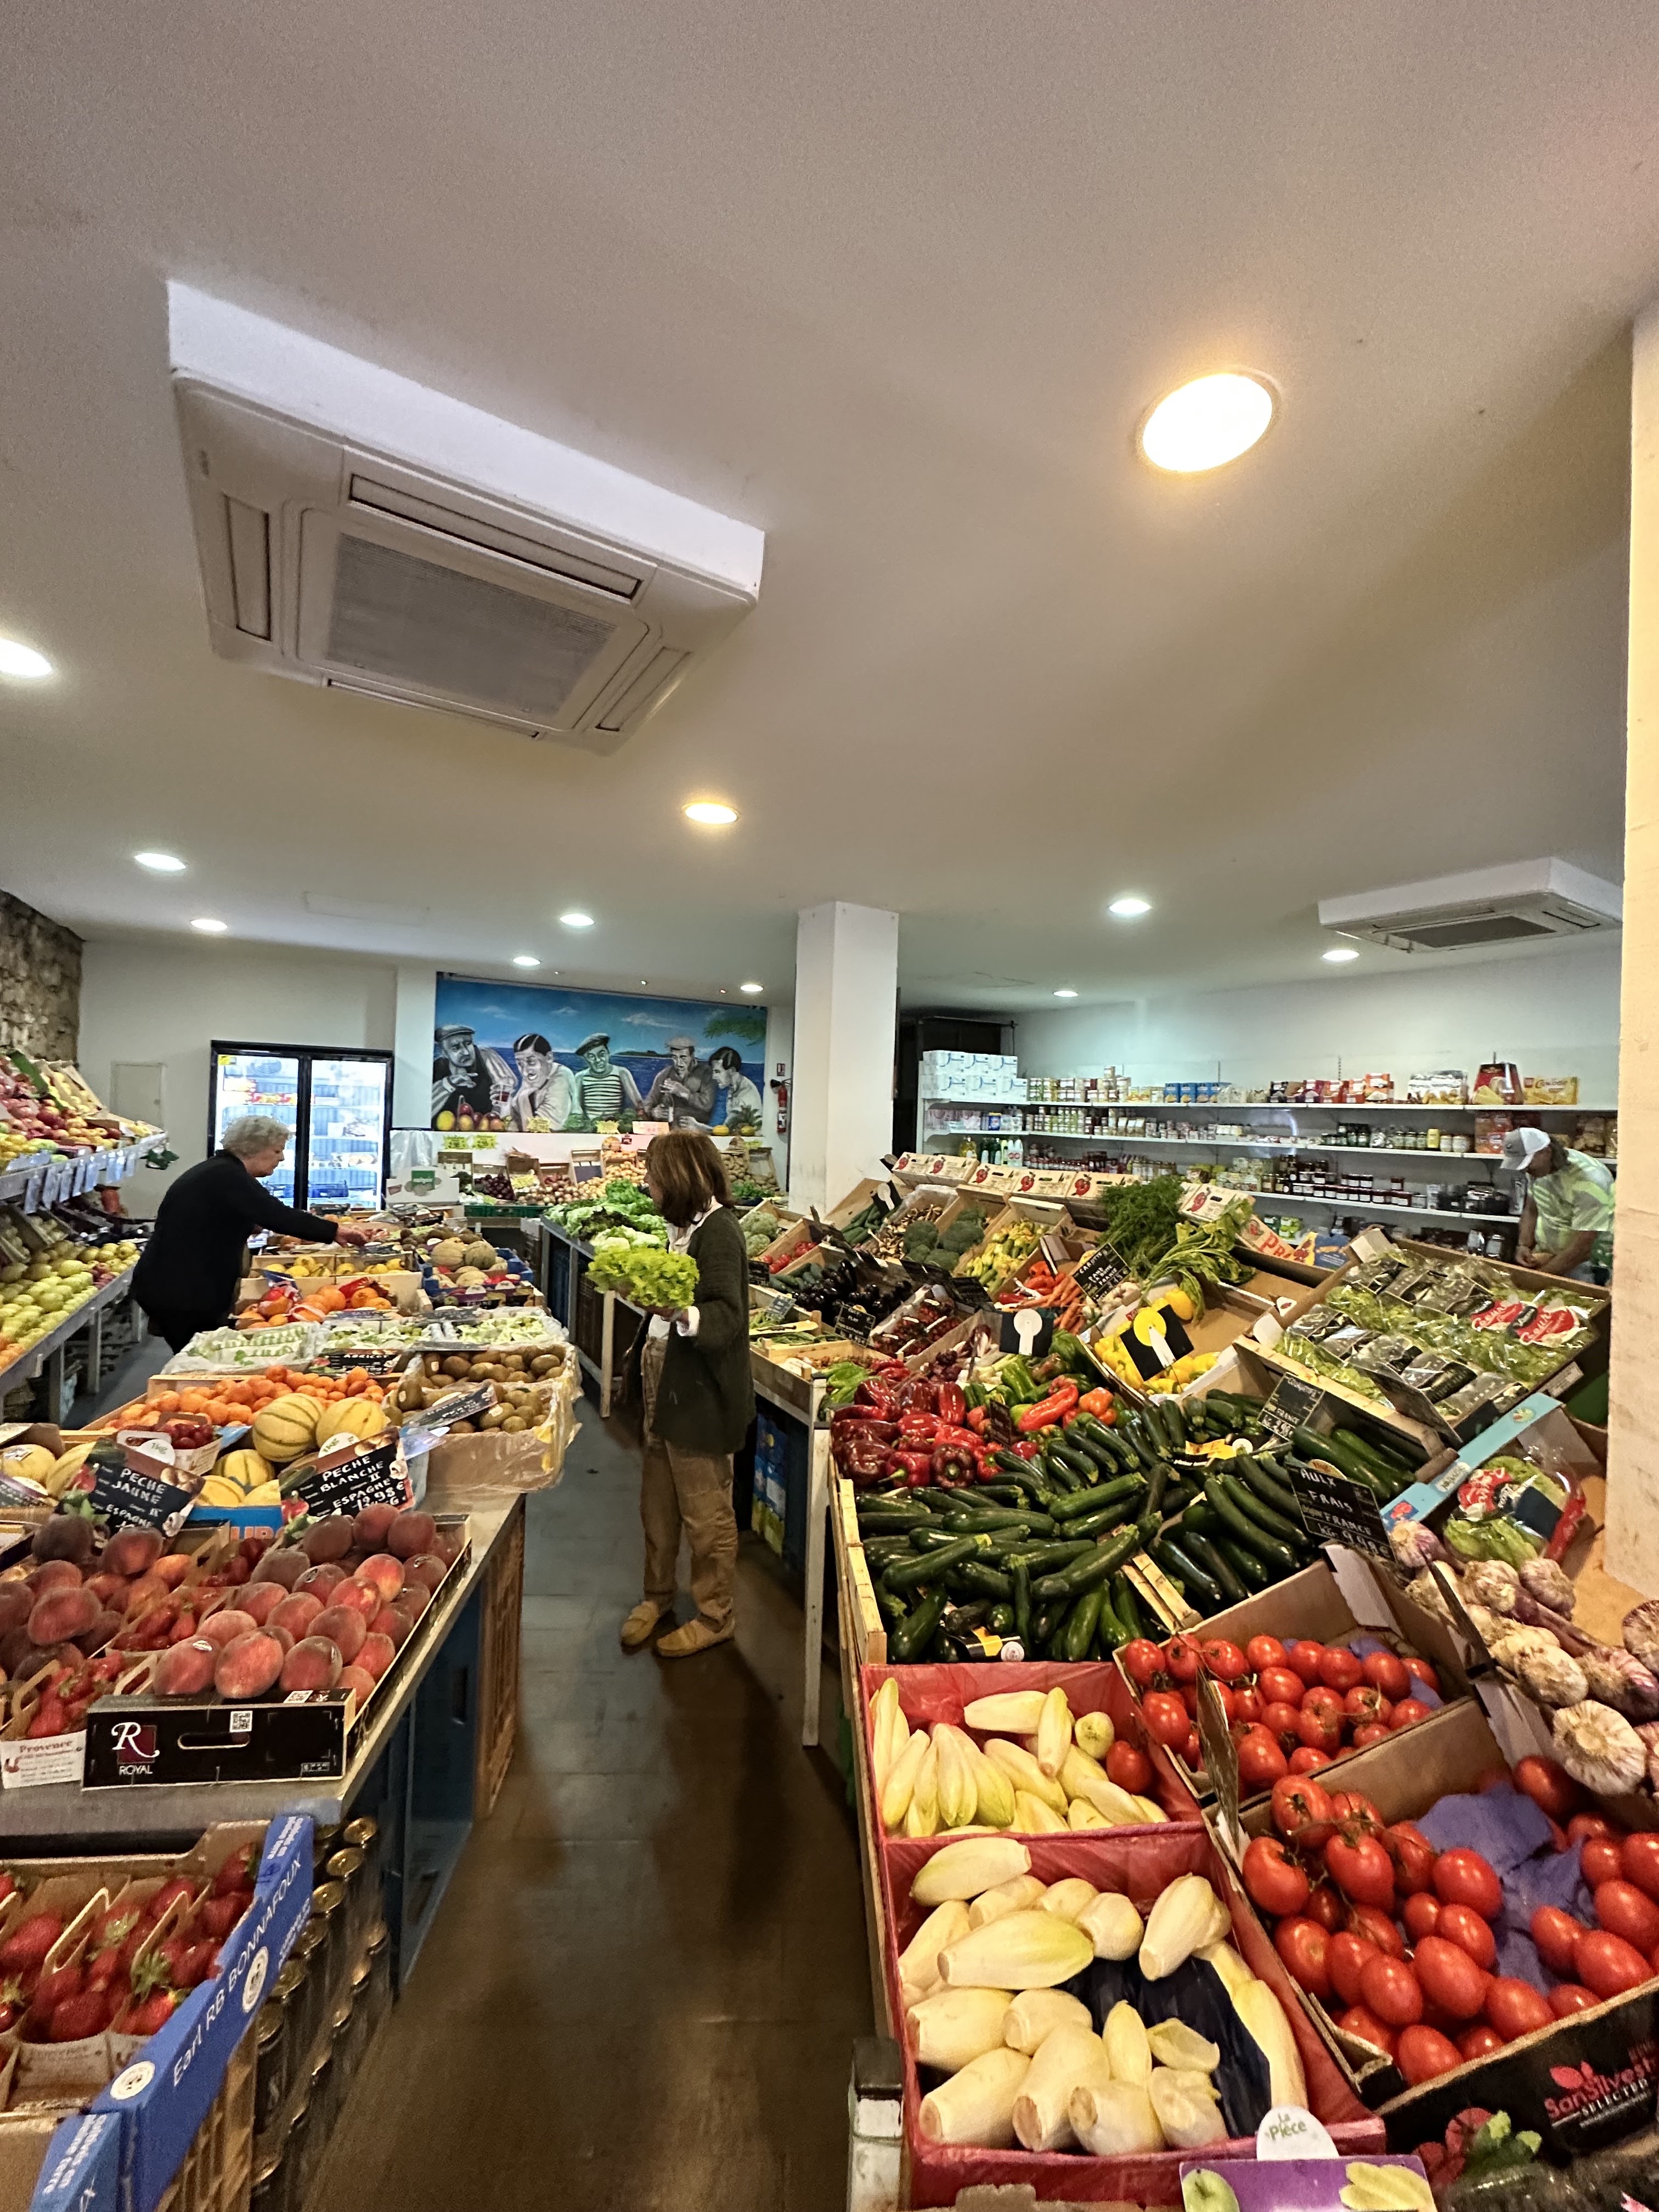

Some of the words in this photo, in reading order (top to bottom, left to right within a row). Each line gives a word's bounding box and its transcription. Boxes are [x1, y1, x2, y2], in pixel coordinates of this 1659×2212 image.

[320, 1461, 384, 1492] BLANCHE
[322, 1456, 371, 1481] PECHE
[1300, 1468, 1336, 1487] AULX
[111, 1481, 163, 1504] JAUNE
[121, 1468, 167, 1494] PECHE
[332, 1478, 391, 1508] ESPAGNE
[1308, 1490, 1353, 1513] FRAIS
[1323, 1512, 1372, 1535] FRANCE
[119, 1765, 153, 1775] ROYAL
[174, 2024, 203, 2087] Earl
[206, 1988, 225, 2030] RB
[228, 1852, 301, 1993] BONNAFOUX
